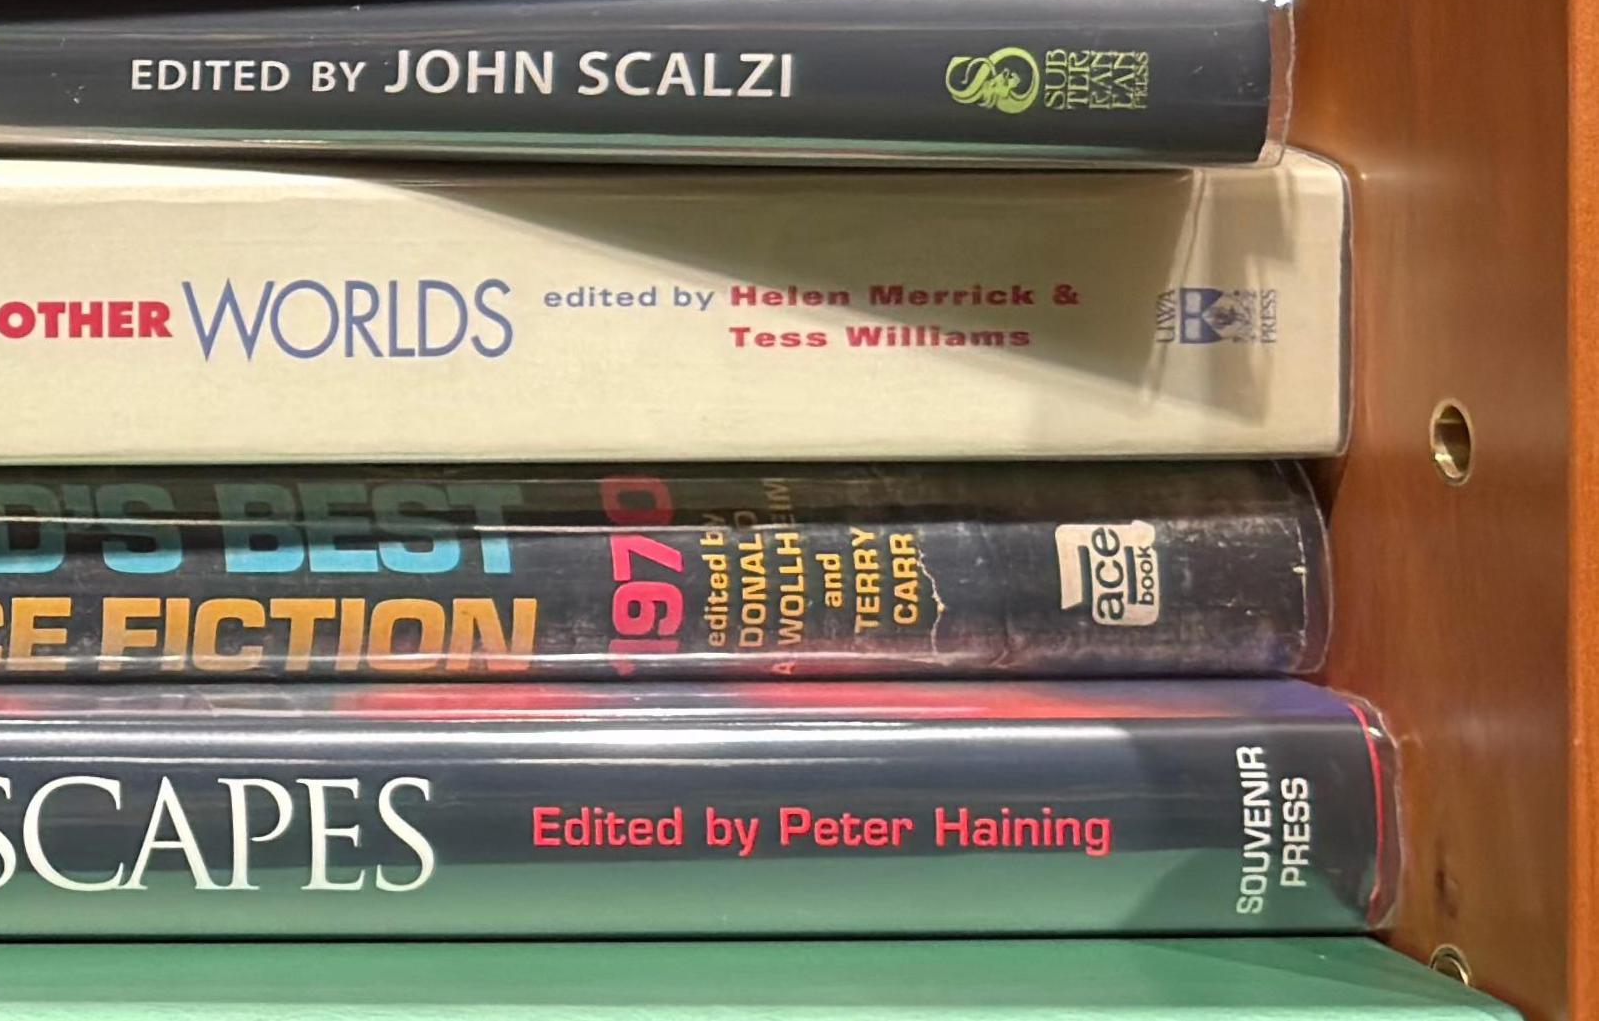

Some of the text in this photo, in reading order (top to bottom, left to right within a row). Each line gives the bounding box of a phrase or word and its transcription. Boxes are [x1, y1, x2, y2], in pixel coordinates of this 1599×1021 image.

[131, 48, 793, 98] EDITED BY JOHN SCALZI
[1045, 49, 1068, 110] SUB
[181, 278, 512, 360] WORLDS
[542, 283, 1078, 316] edited by Helen Merrick &
[729, 324, 1030, 350] Tess Williams
[1260, 289, 1276, 343] PRESS
[221, 483, 524, 575] BEST
[601, 475, 684, 676] 1970
[700, 513, 728, 647] edited by
[816, 553, 844, 607] and
[850, 526, 880, 634] TERRY
[890, 533, 918, 625] CARR
[1092, 527, 1124, 620] ace
[97, 597, 538, 676] FICTION
[532, 806, 1111, 857] Edited by Peter Haining
[1236, 744, 1266, 916] SOUVENIR
[1282, 777, 1309, 887] PRESS
